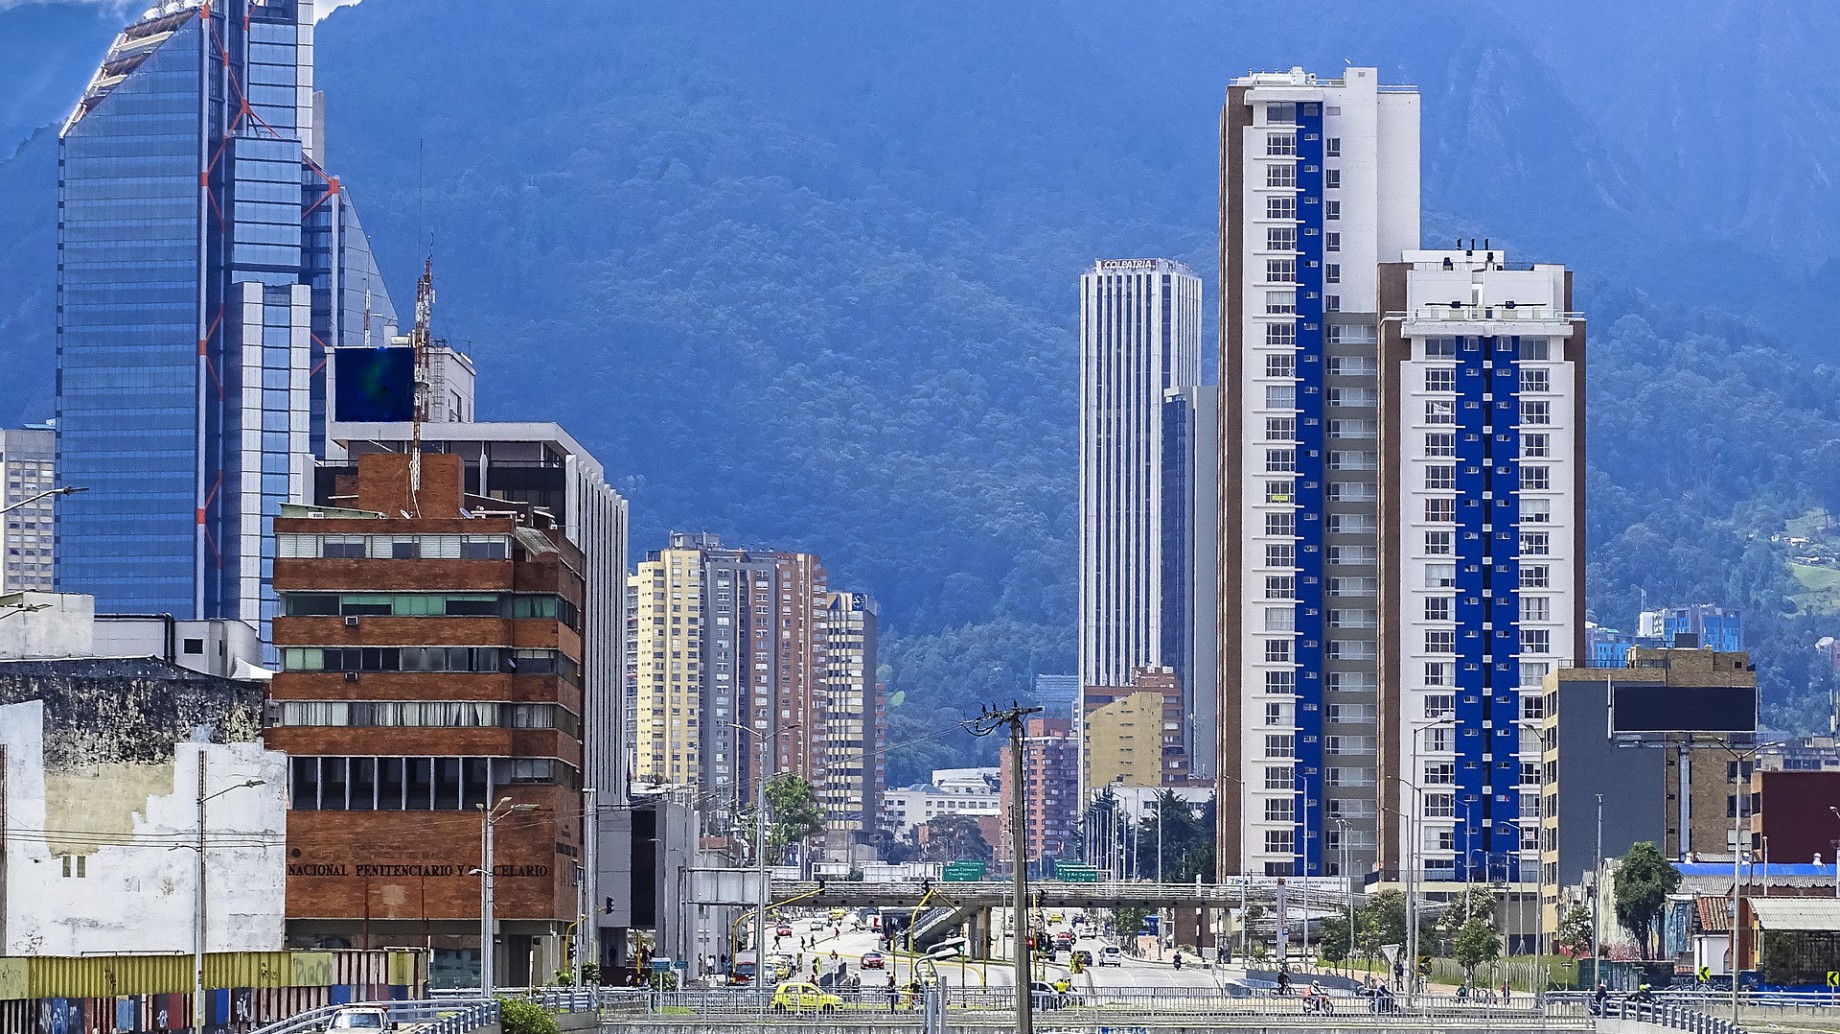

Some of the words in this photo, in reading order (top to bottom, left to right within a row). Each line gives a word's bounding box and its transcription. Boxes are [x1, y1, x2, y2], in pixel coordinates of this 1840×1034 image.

[1104, 259, 1152, 269] COLPATRIA
[288, 864, 349, 876] NACIONAL
[355, 864, 453, 877] PENITENCIARIO
[457, 864, 466, 877] Y
